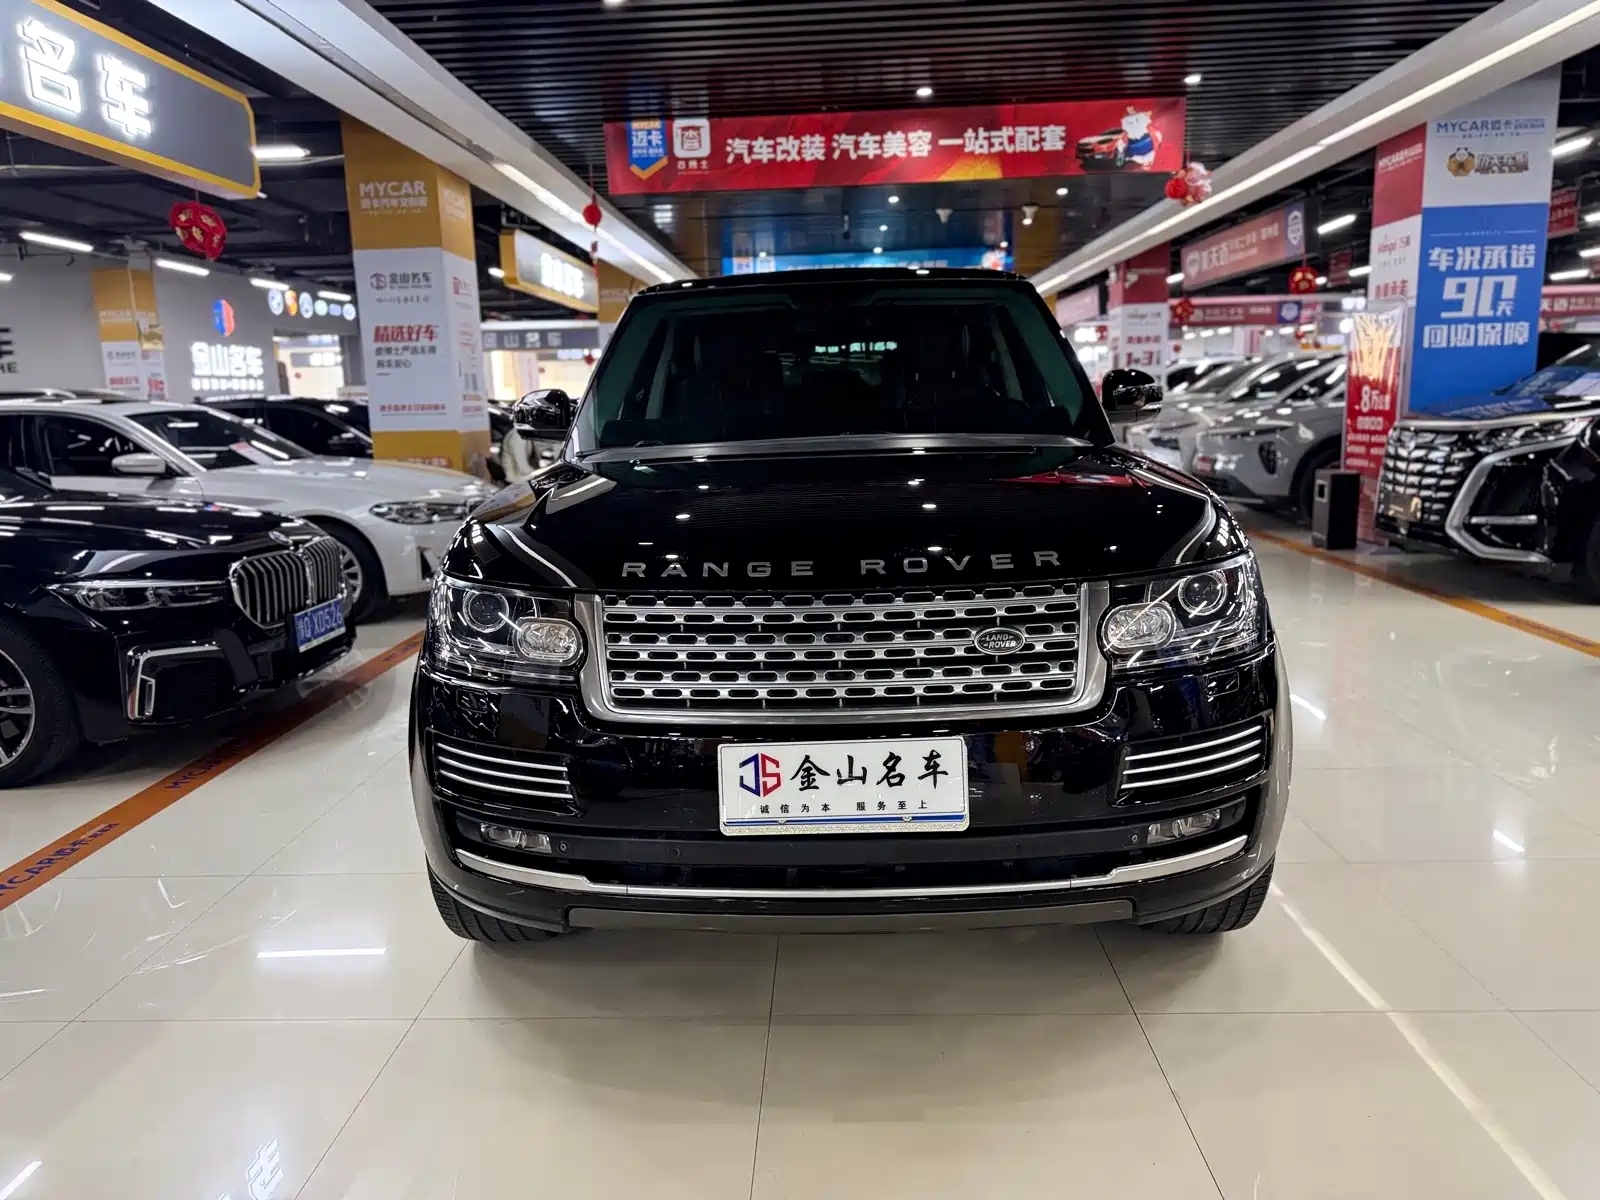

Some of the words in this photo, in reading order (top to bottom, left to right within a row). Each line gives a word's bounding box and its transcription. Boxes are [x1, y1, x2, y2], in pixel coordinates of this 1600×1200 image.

[17, 16, 153, 138] 名车
[726, 134, 826, 165] 汽车改装
[832, 129, 932, 161] 汽车美容
[938, 125, 1066, 155] 一站式配套
[358, 180, 427, 197] MYCAR
[1428, 244, 1536, 271] 车况承诺
[373, 324, 440, 343] 精选好车
[1423, 321, 1530, 348] 回购保障
[622, 561, 814, 578] RANGE
[860, 550, 1061, 575] ROVER
[986, 633, 1009, 641] LAND
[989, 640, 1017, 649] ROVER
[790, 749, 949, 792] 金山名车
[760, 803, 831, 814] 诚信为本
[856, 799, 928, 811] 服务至上
